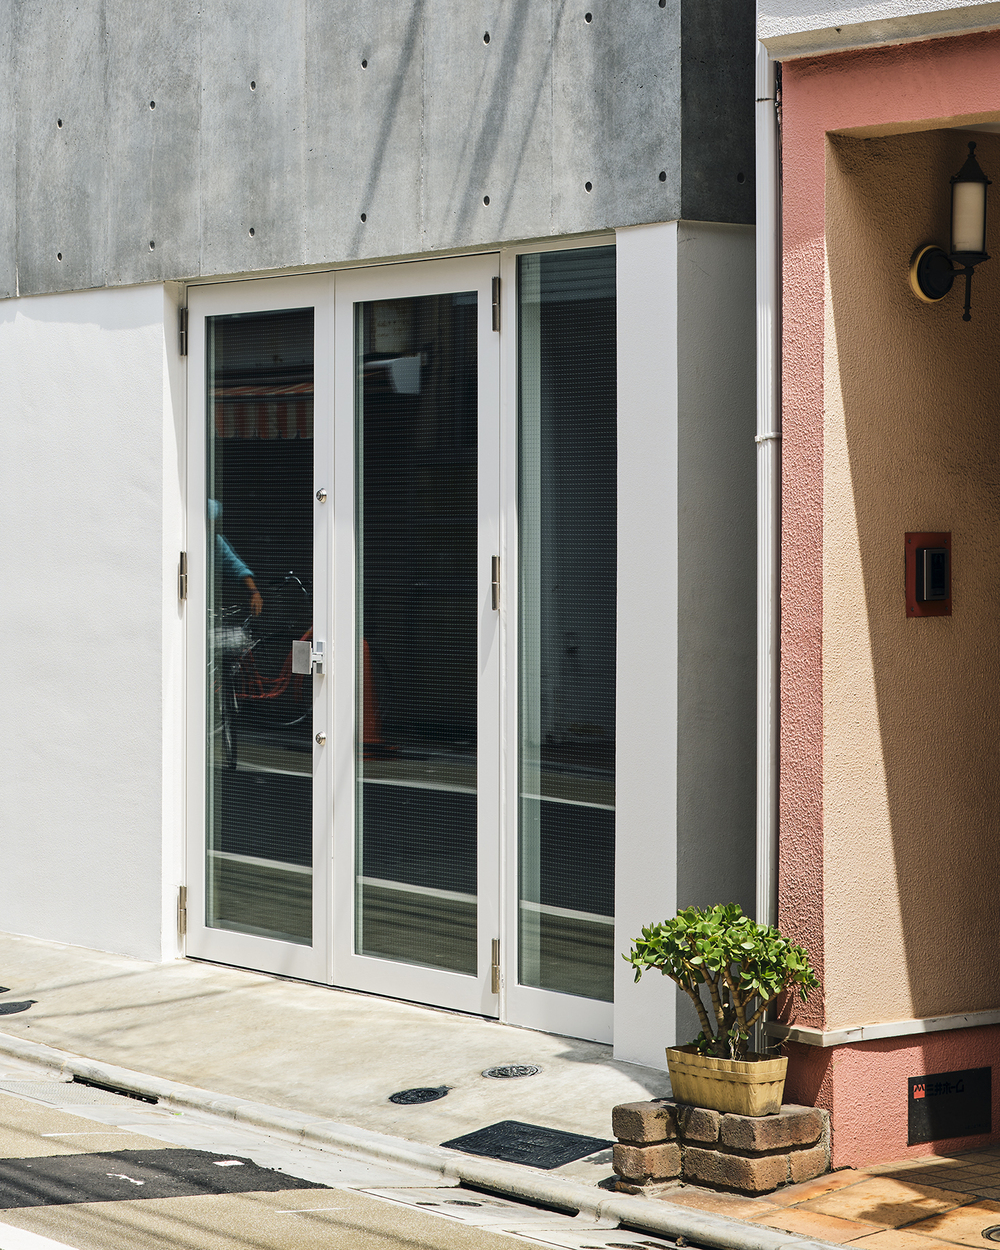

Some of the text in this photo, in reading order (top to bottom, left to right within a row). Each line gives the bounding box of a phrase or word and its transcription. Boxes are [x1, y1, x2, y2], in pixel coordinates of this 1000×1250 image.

[926, 1079, 965, 1097] 三井ホーム
